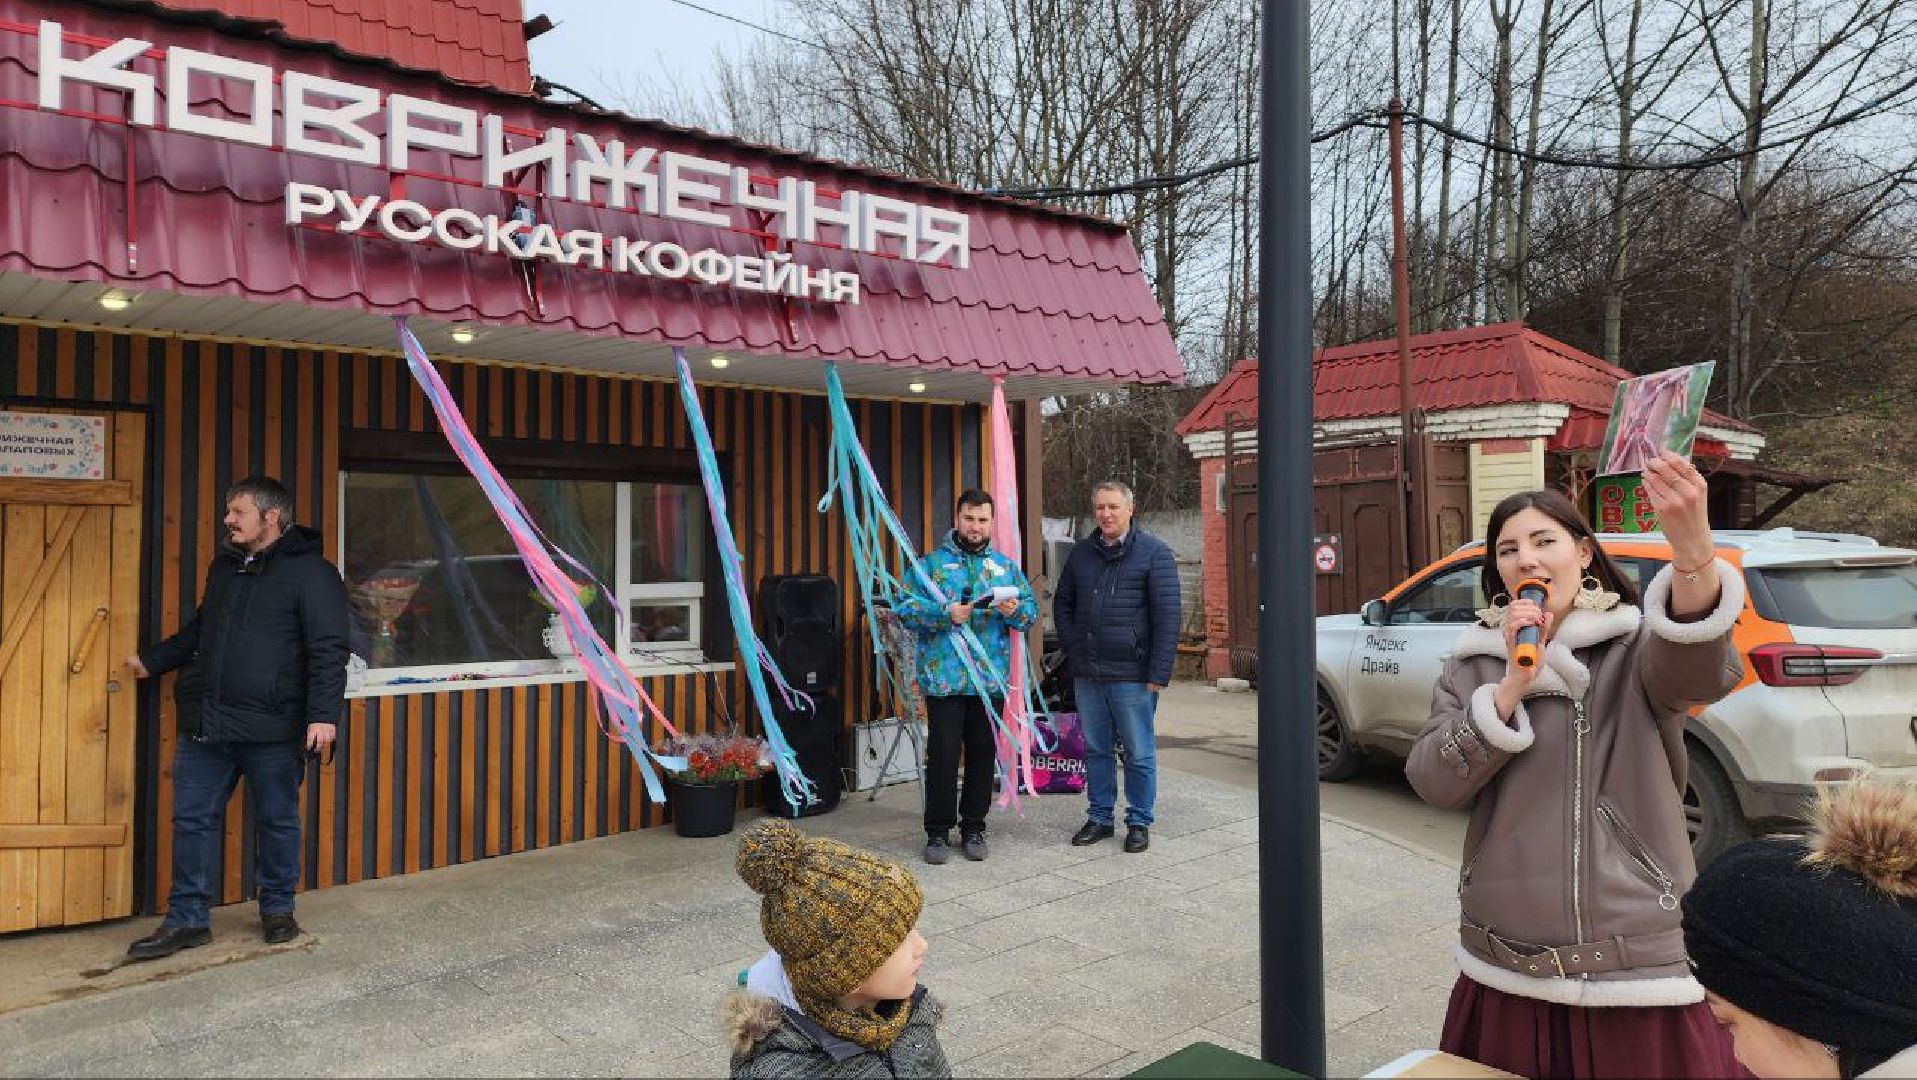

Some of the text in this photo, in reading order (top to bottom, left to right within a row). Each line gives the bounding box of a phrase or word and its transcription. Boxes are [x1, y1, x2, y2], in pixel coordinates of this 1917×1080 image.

[38, 19, 971, 269] КОВРИЖЕЧНАЯ
[286, 182, 861, 305] РУССКАЯ КОФЕЙНЯ
[0, 434, 74, 444] ИЖЕЧНАЯ
[0, 446, 75, 455] ЛАПОВЫХ
[1365, 634, 1408, 652] Яндекс
[1361, 656, 1399, 675] Драйв
